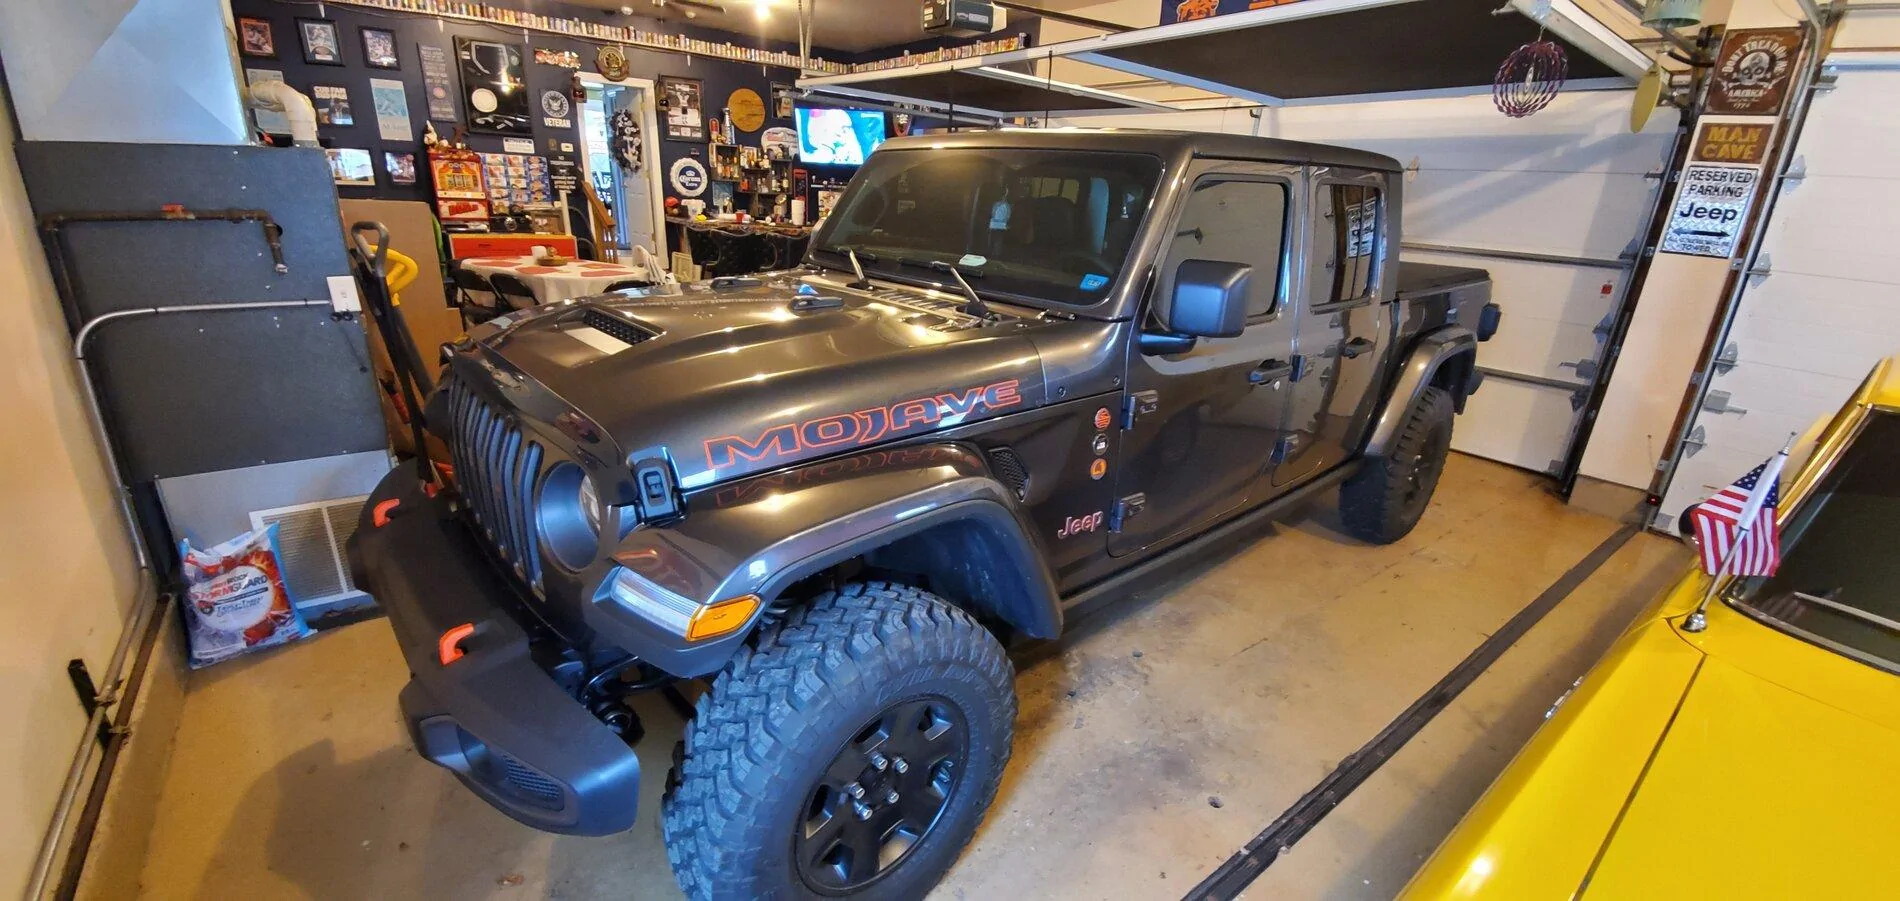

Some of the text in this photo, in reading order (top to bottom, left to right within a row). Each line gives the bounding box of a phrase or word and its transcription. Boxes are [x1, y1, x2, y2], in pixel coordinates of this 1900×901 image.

[1727, 88, 1765, 98] AMERICA
[543, 117, 571, 128] VETERAN
[1706, 126, 1763, 142] MAN
[1701, 143, 1757, 160] CAVE
[1689, 169, 1753, 183] RESERVED
[1688, 184, 1744, 198] PARKING
[1680, 202, 1738, 223] Jeep
[703, 379, 1022, 469] MOJAVE
[1057, 510, 1104, 540] Jeep
